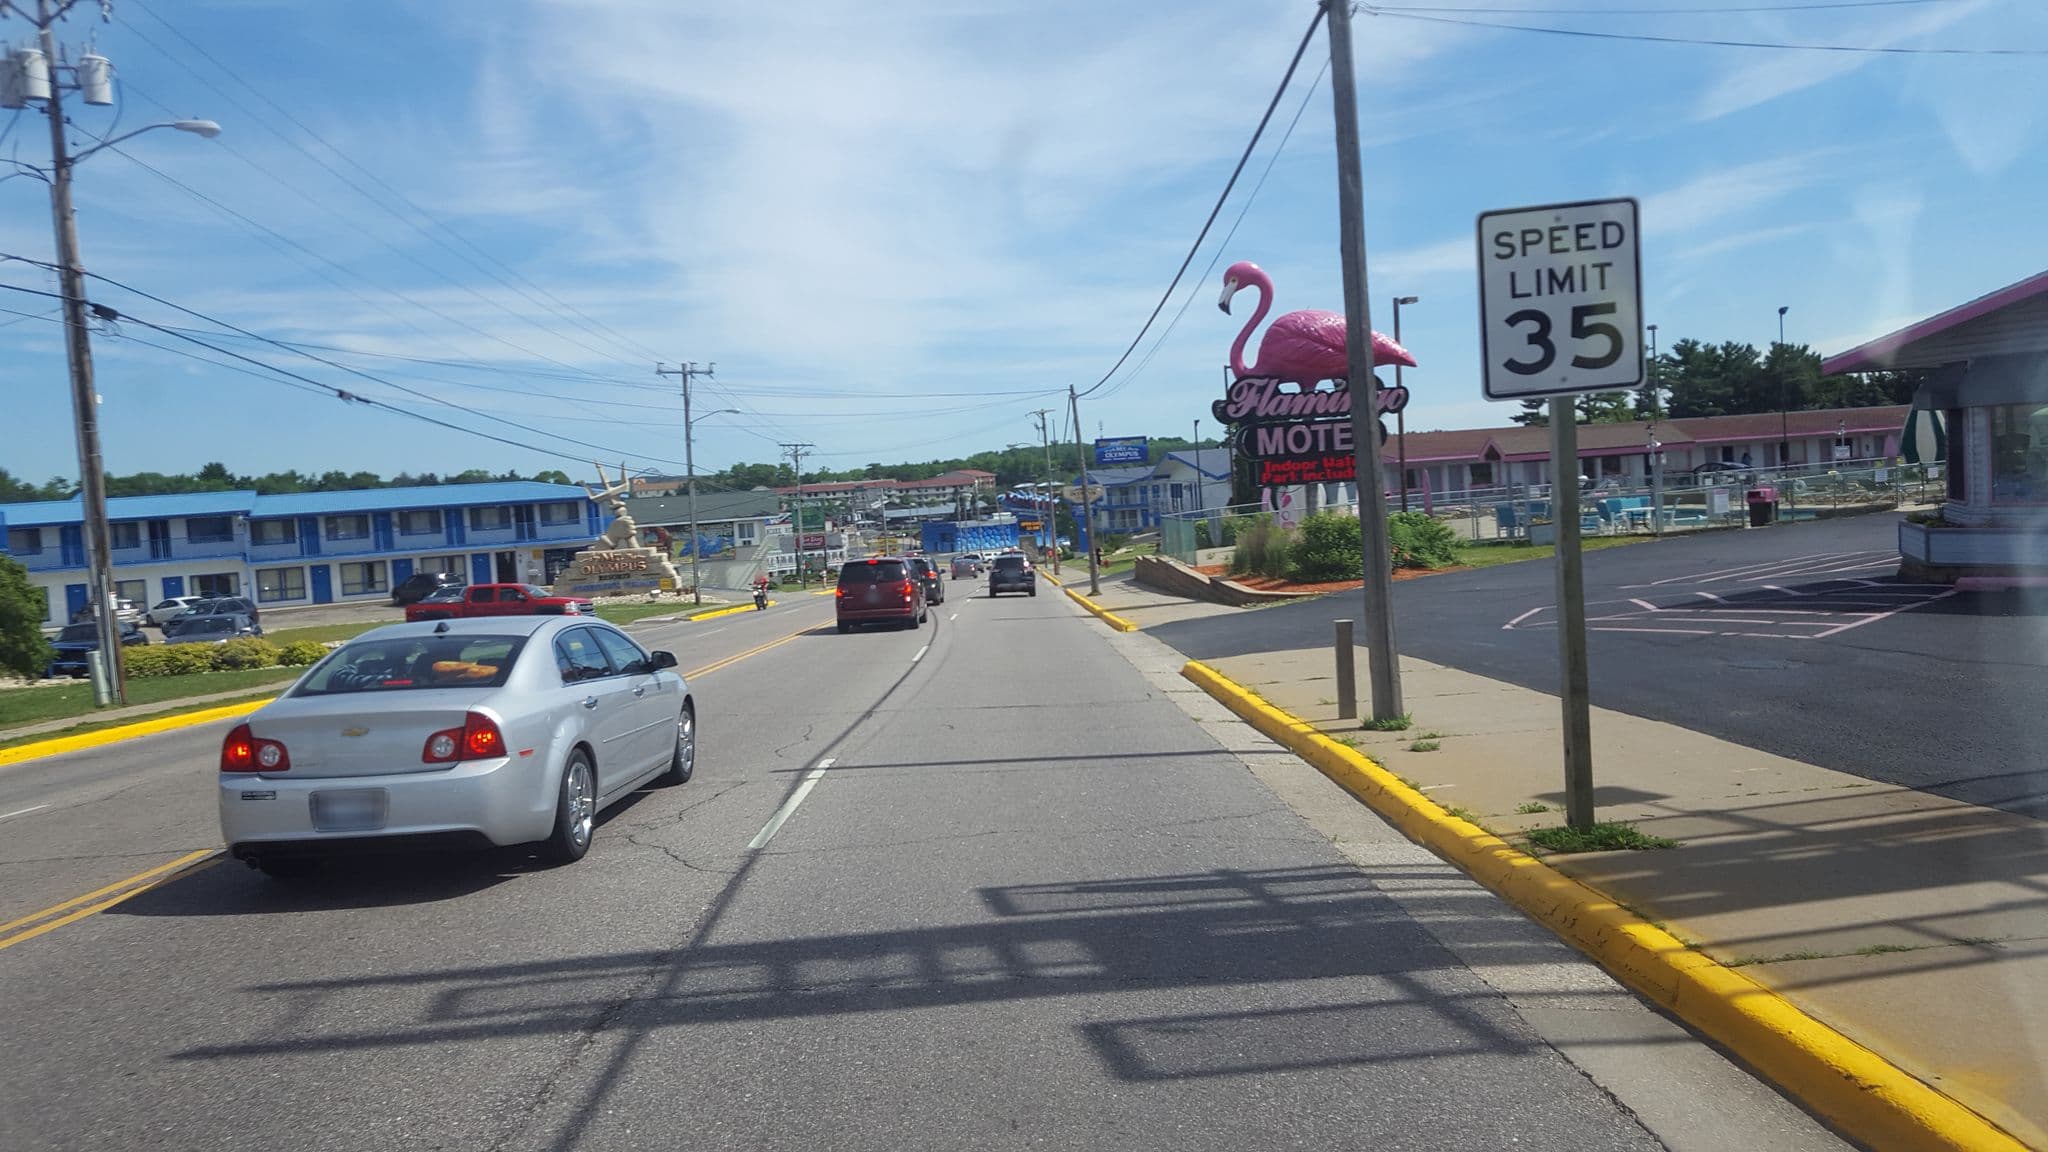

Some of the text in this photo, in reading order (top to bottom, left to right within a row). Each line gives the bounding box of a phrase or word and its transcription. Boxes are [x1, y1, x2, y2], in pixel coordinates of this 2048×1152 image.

[1494, 221, 1625, 260] SPEED
[1510, 262, 1613, 299] LIMIT
[1503, 302, 1625, 375] 35
[1257, 422, 1354, 455] MOTE
[1263, 459, 1318, 472] Indoor
[1302, 466, 1357, 481] includ
[583, 561, 646, 575] OLYMPUS
